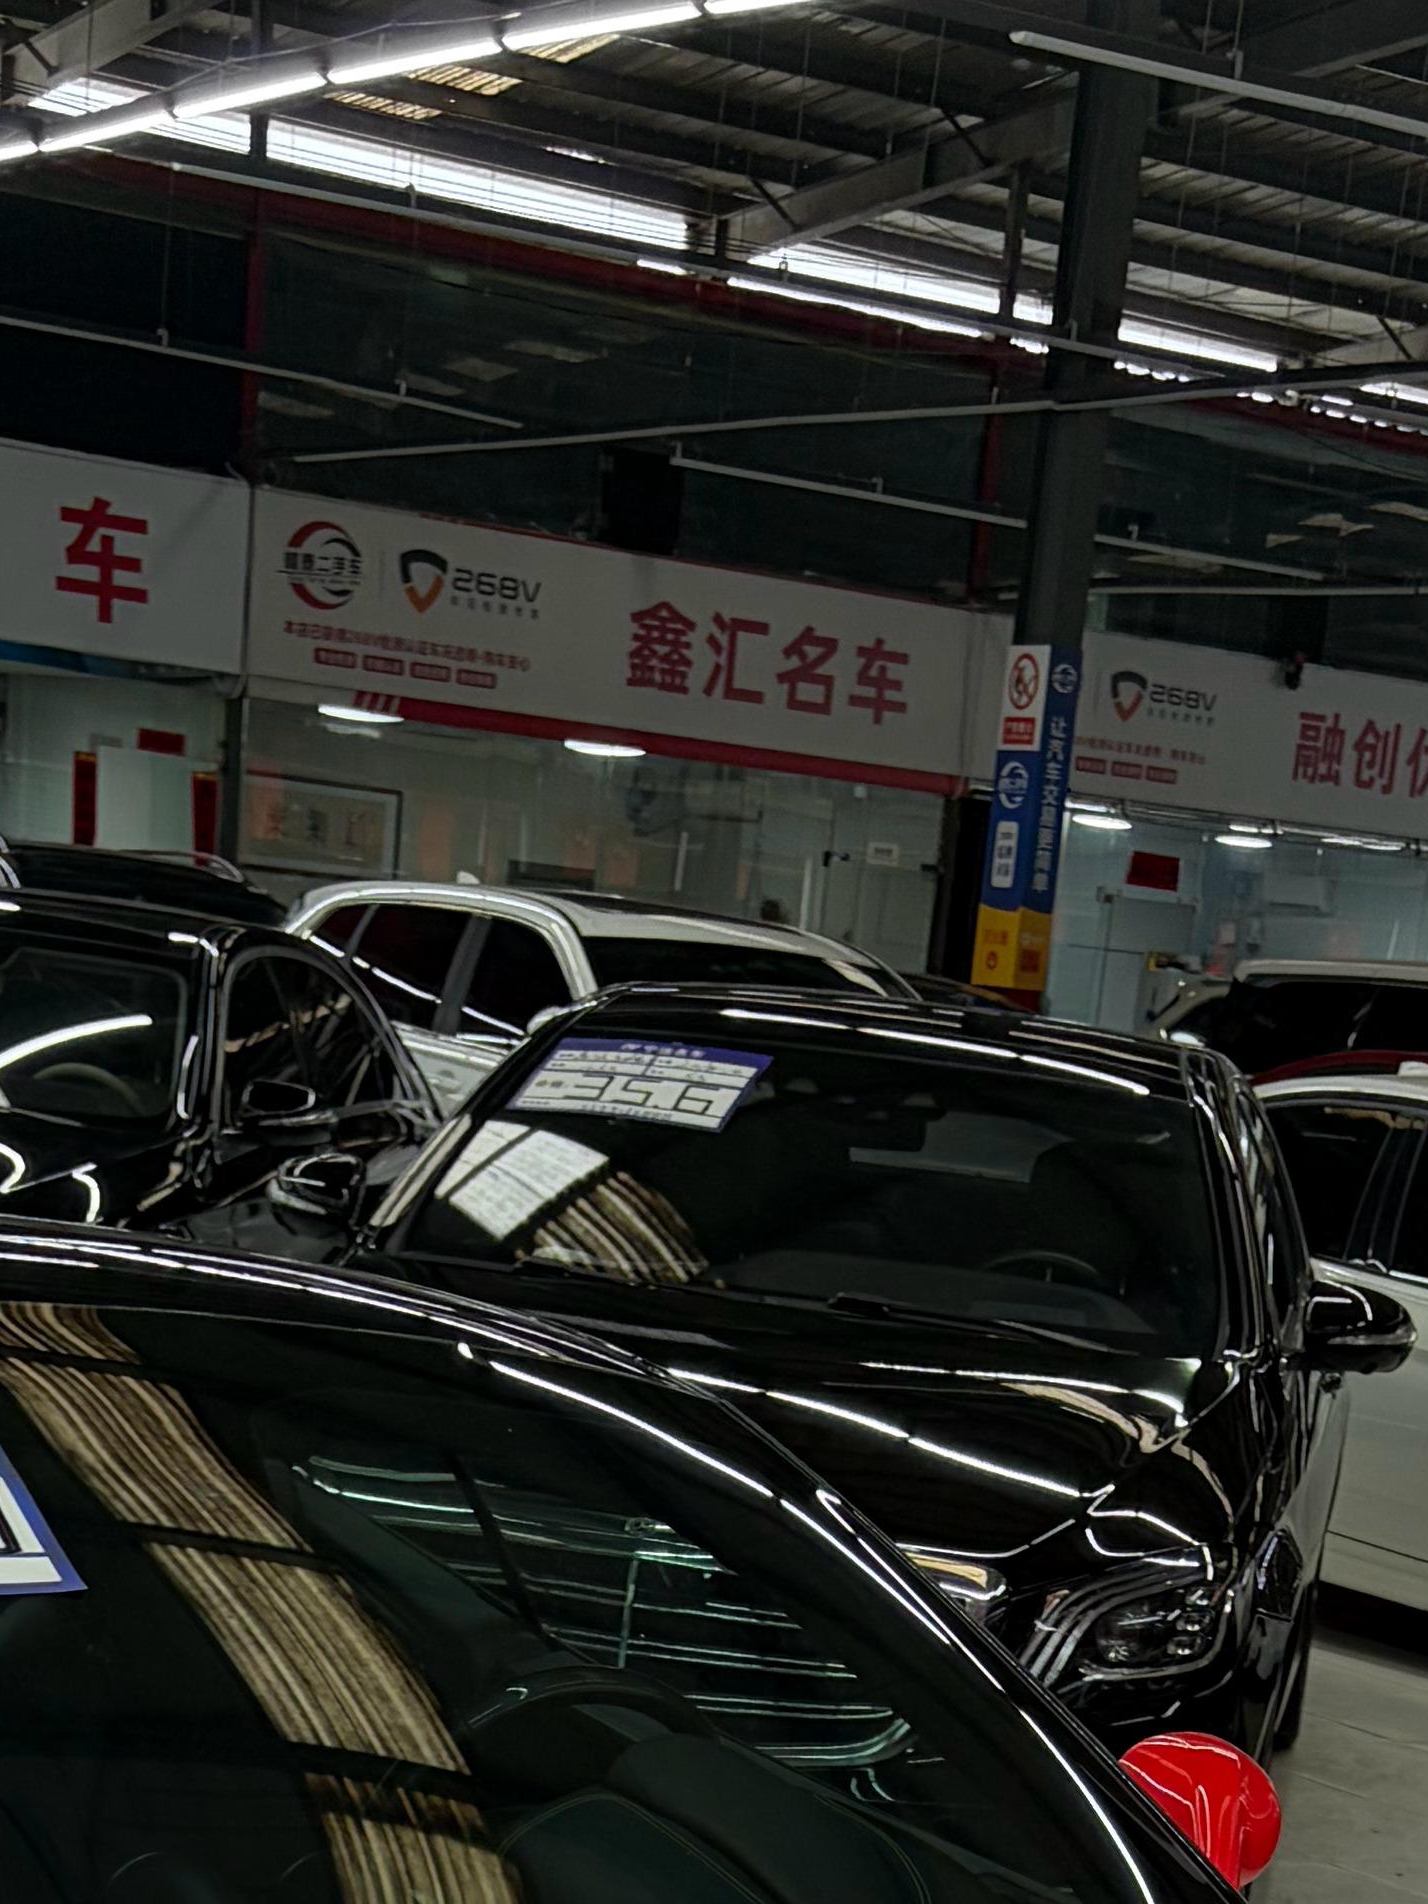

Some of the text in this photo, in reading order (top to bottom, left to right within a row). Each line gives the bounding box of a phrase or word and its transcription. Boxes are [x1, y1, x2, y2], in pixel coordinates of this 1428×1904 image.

[451, 567, 542, 603] 268V
[627, 601, 910, 725] 鑫汇名车
